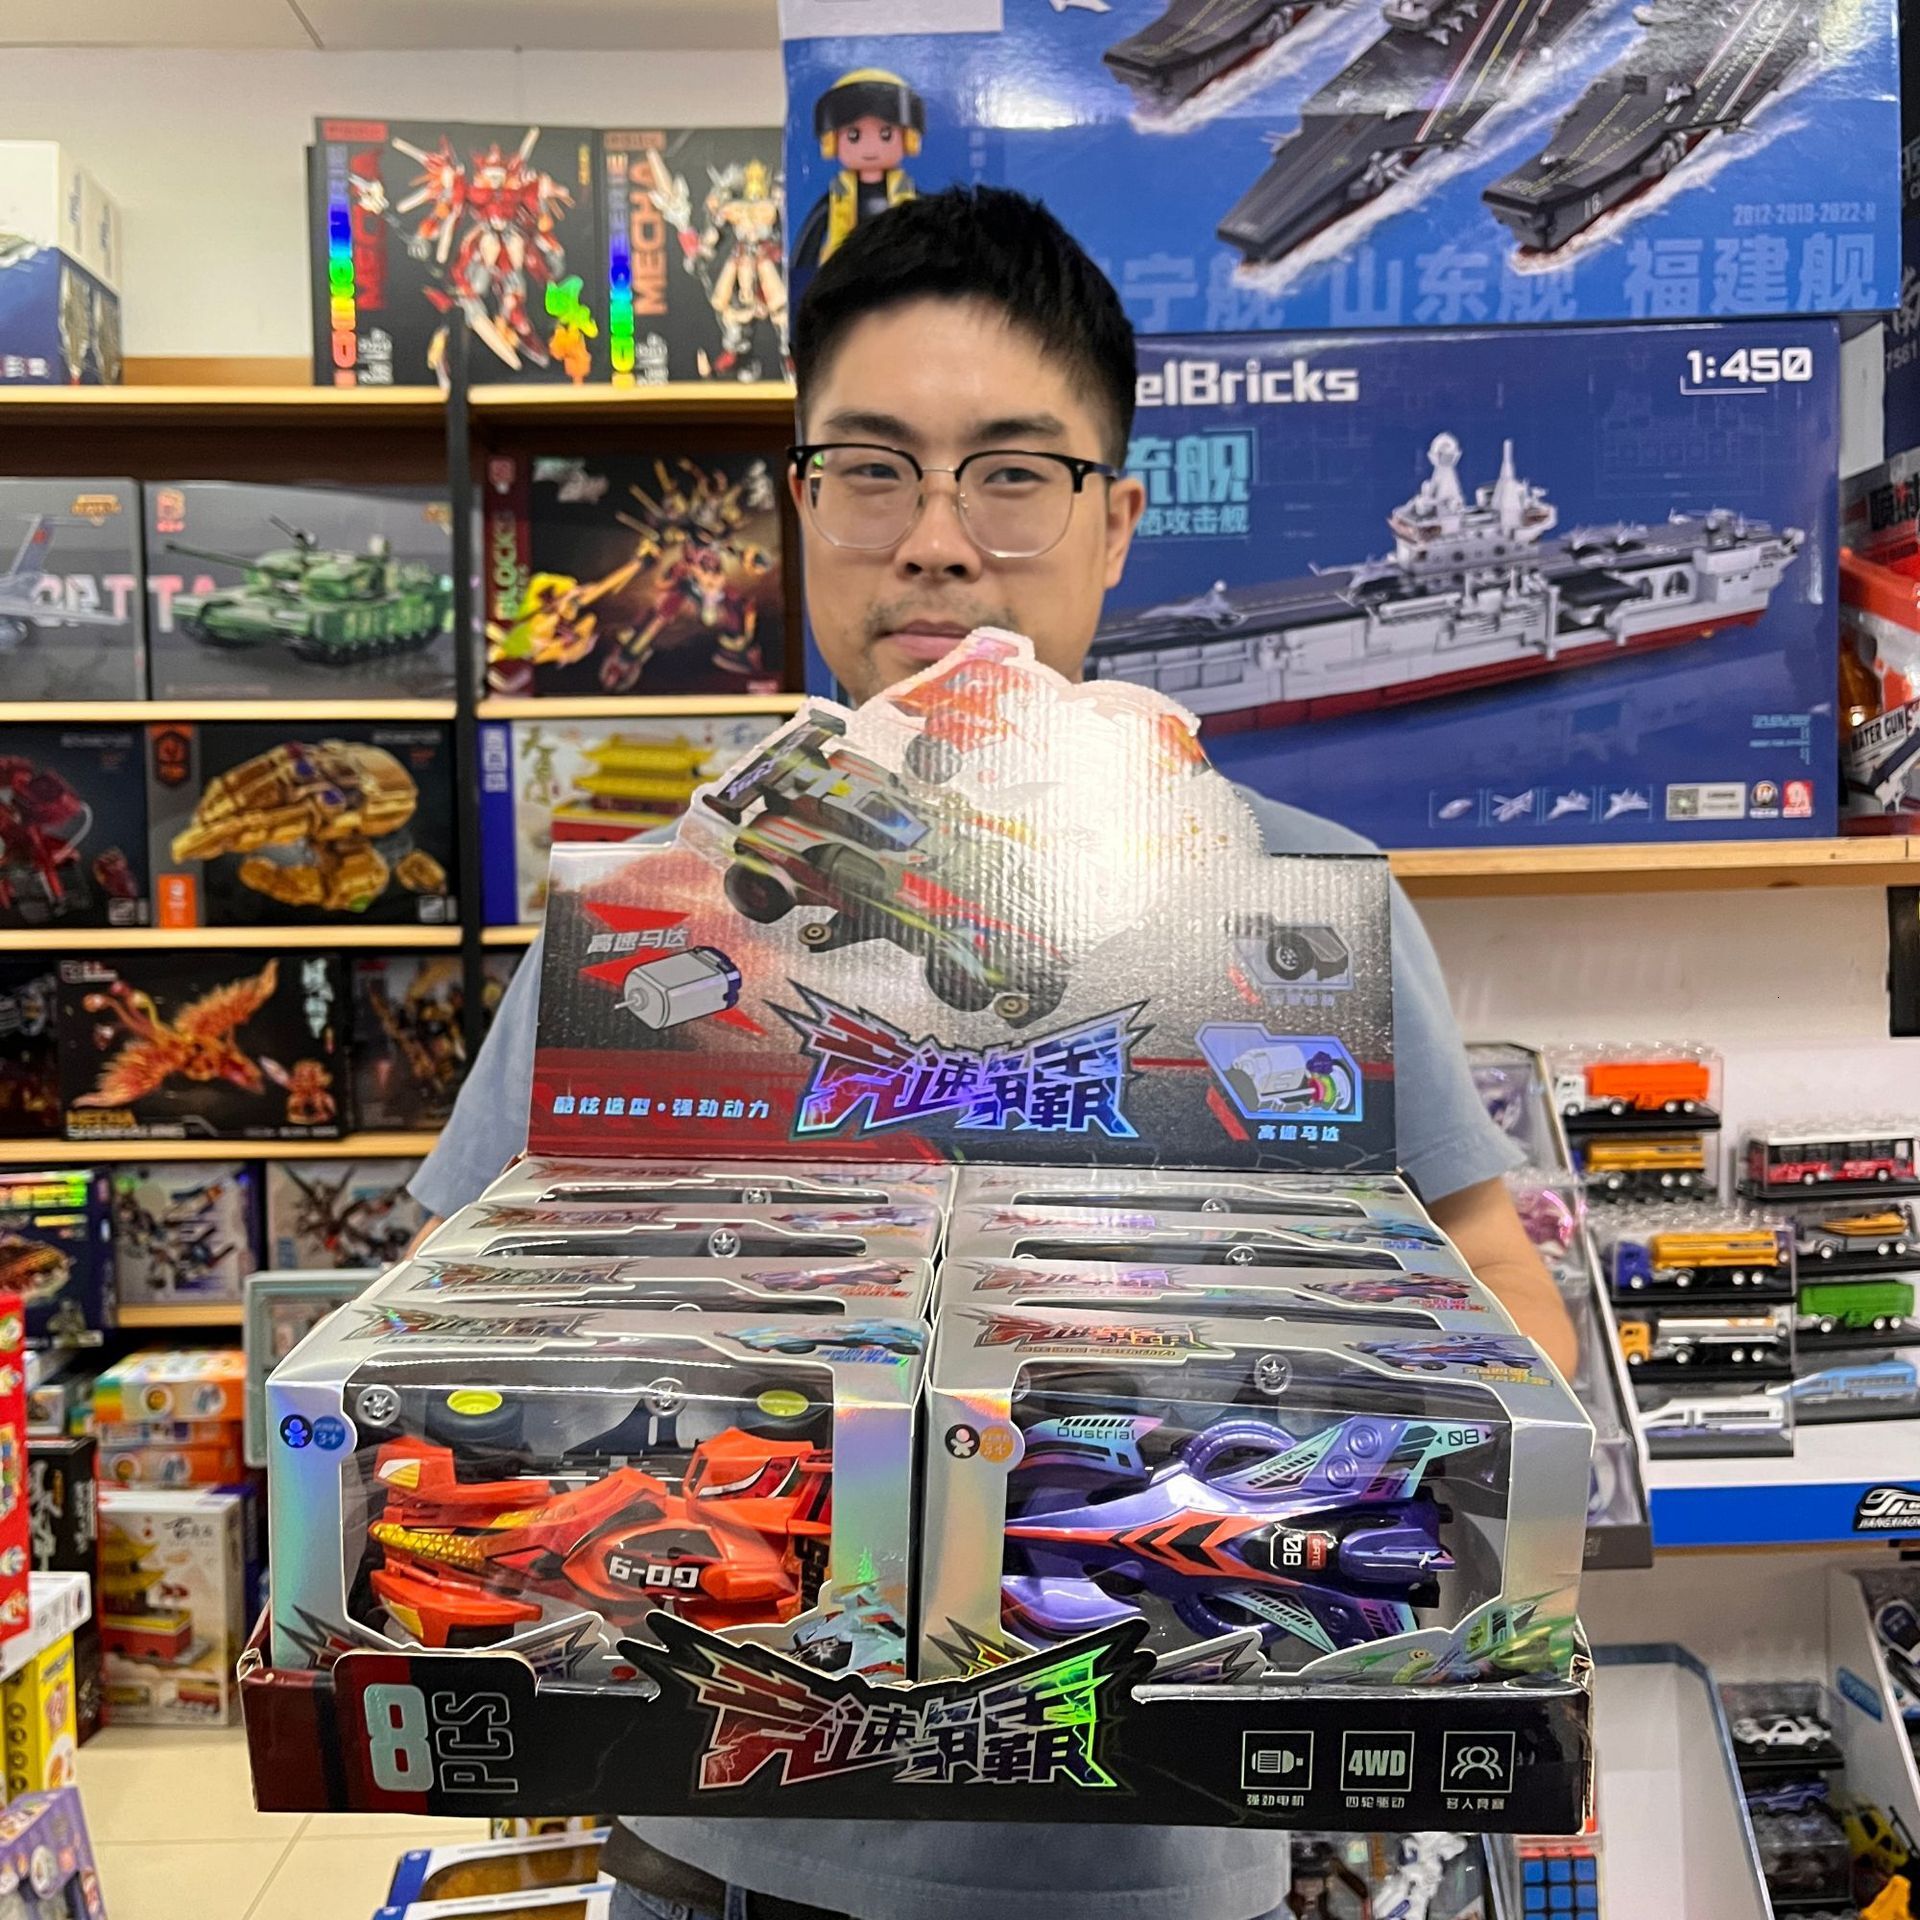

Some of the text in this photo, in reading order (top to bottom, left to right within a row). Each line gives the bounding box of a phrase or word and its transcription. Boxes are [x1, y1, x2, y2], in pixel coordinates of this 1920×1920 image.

[1100, 252, 1286, 331] 宁舰
[1624, 231, 1879, 317] 福建舰
[1687, 347, 1814, 384] 1:450
[1134, 358, 1360, 407] elBricks
[587, 927, 690, 955] 高速马达
[1256, 1124, 1341, 1142] 高速马达
[363, 1683, 519, 1794] 8 PCS
[1348, 1749, 1406, 1777] 4WD
[1245, 1793, 1305, 1807] 强劲电机
[1345, 1795, 1405, 1809] 四轮驱动
